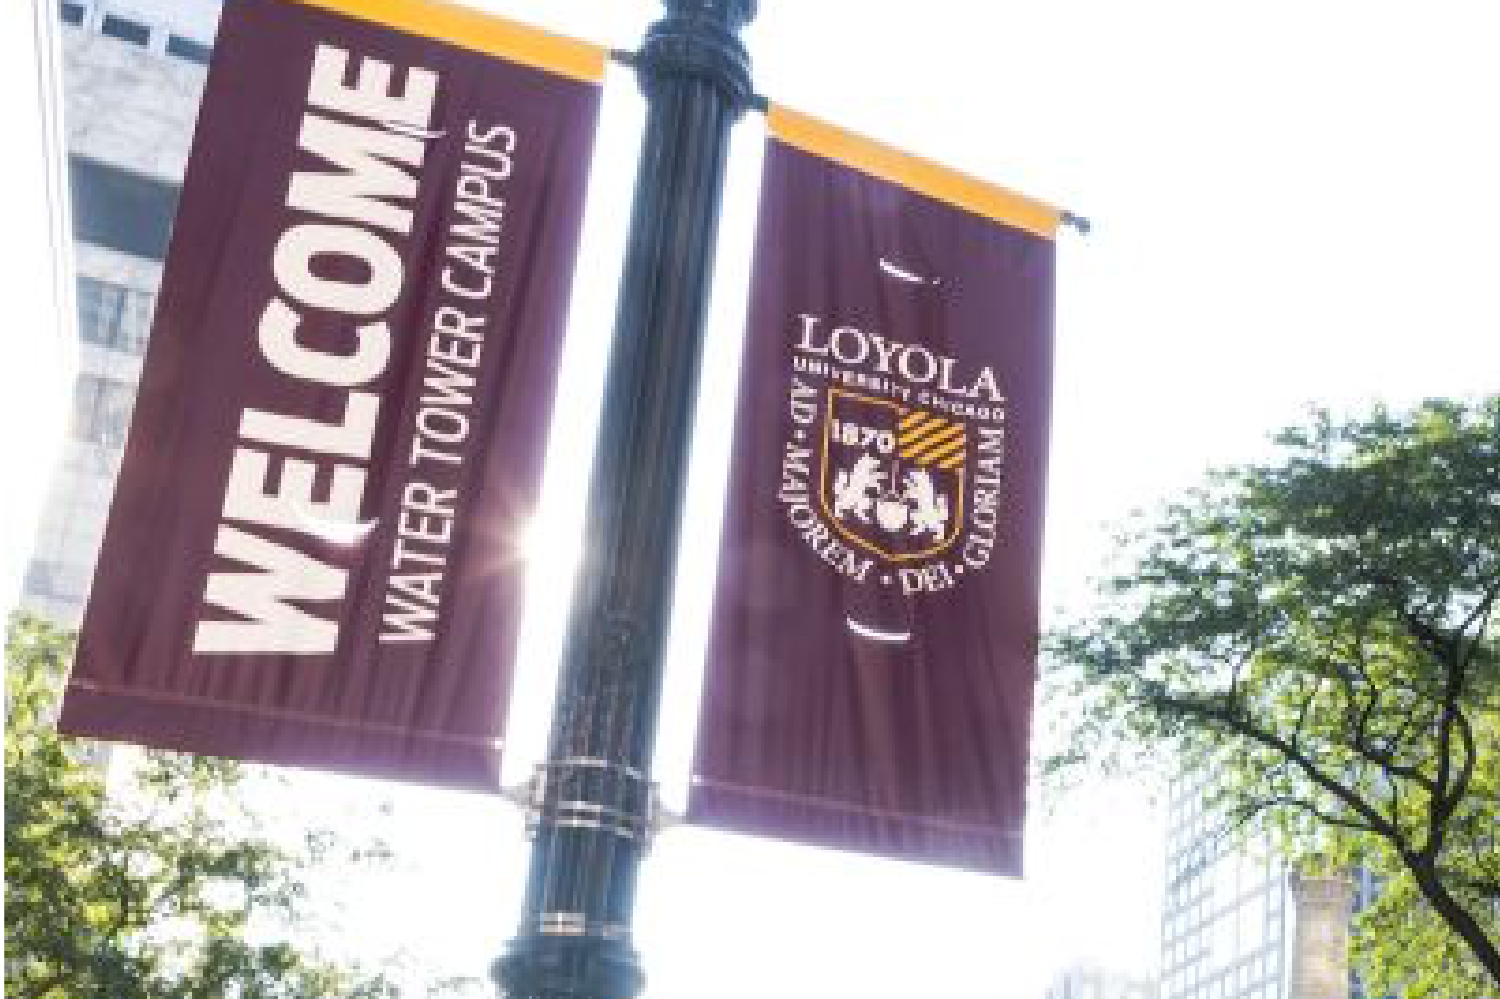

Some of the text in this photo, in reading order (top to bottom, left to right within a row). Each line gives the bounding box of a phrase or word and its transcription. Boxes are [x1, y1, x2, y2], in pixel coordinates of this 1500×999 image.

[191, 44, 440, 656] WELCOME
[379, 119, 519, 645] WATER TOWER CAMPUS
[796, 313, 1006, 402] LOYOLA
[831, 418, 897, 454] 1870
[778, 377, 1006, 595] AD MAJOREM DEI GLORIAM
